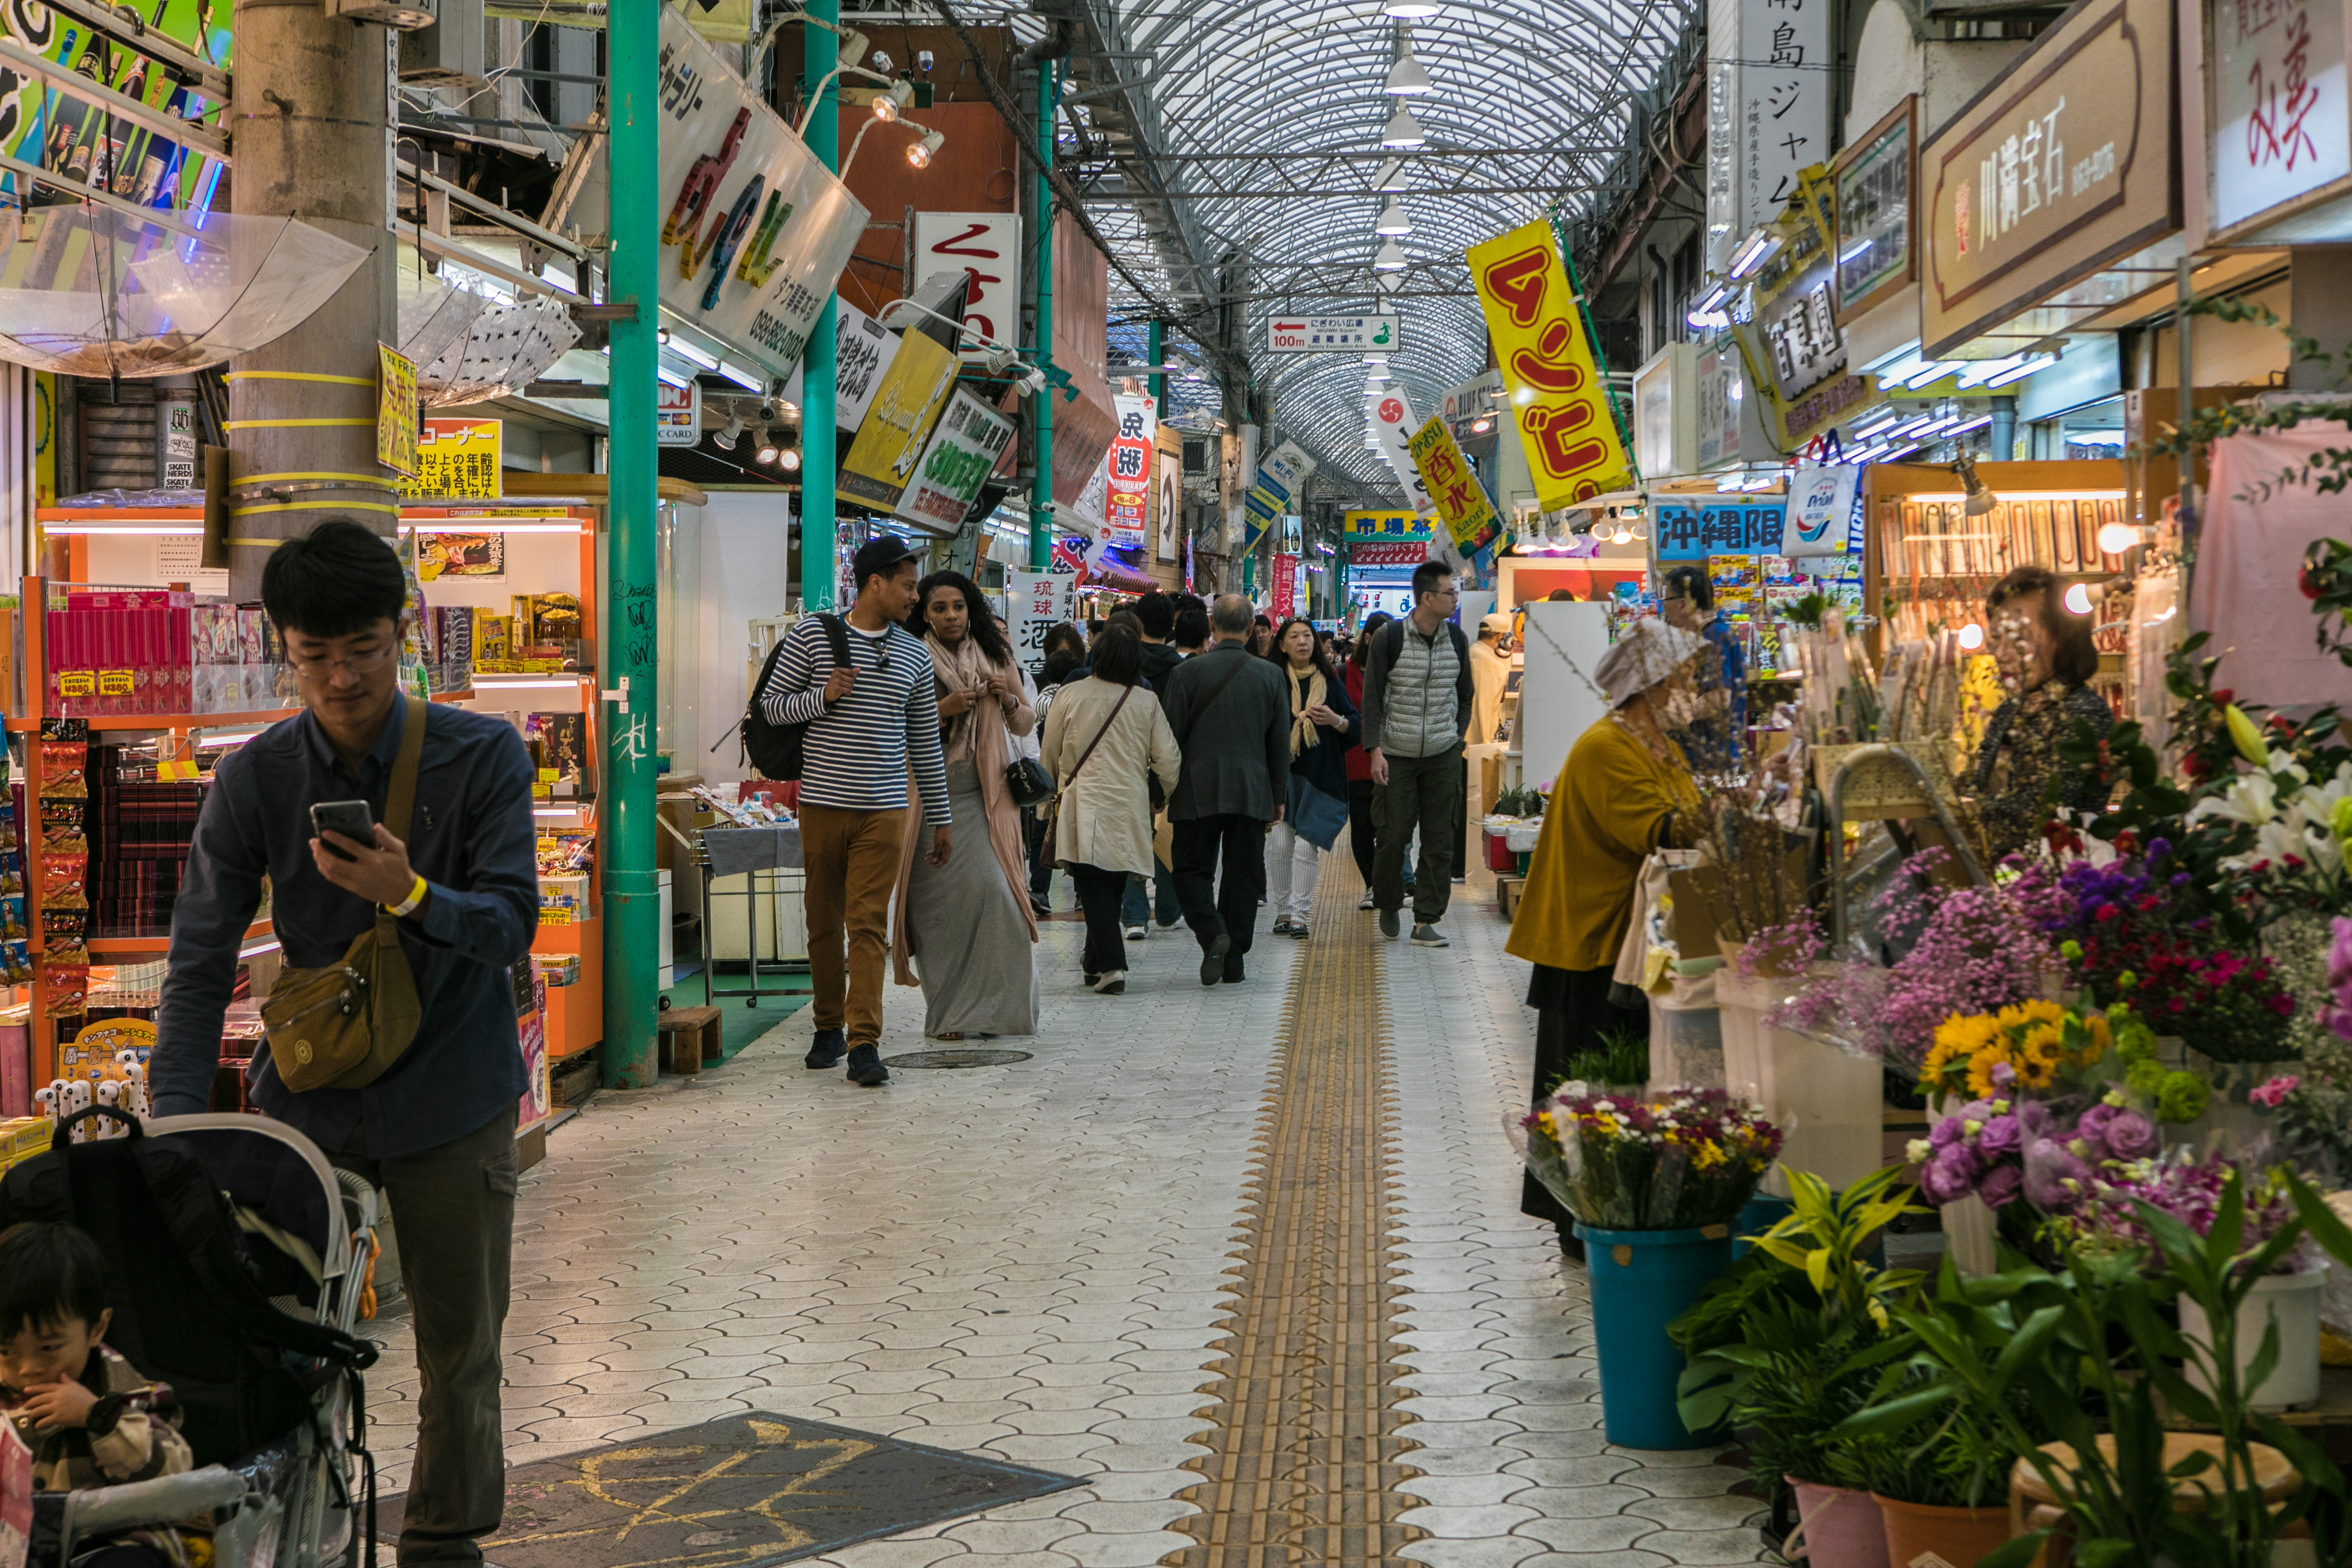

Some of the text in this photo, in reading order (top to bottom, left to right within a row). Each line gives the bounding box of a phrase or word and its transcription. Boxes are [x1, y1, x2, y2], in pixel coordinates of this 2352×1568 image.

[1768, 0, 1808, 203] 島ジャム
[1311, 319, 1363, 327] にぎわい広場
[1274, 336, 1304, 347] 100m
[1312, 335, 1363, 343] 避難場所
[382, 350, 415, 378] TAX FREE
[417, 427, 494, 446] コーナー
[1411, 421, 1443, 458] かおり
[1425, 444, 1477, 520] 香水
[1454, 505, 1486, 536] Kaori
[1280, 559, 1294, 612] 沖縄コスメ
[64, 684, 89, 693] ¥380
[104, 684, 128, 692] ¥380
[83, 1028, 117, 1044] チンアナゴ
